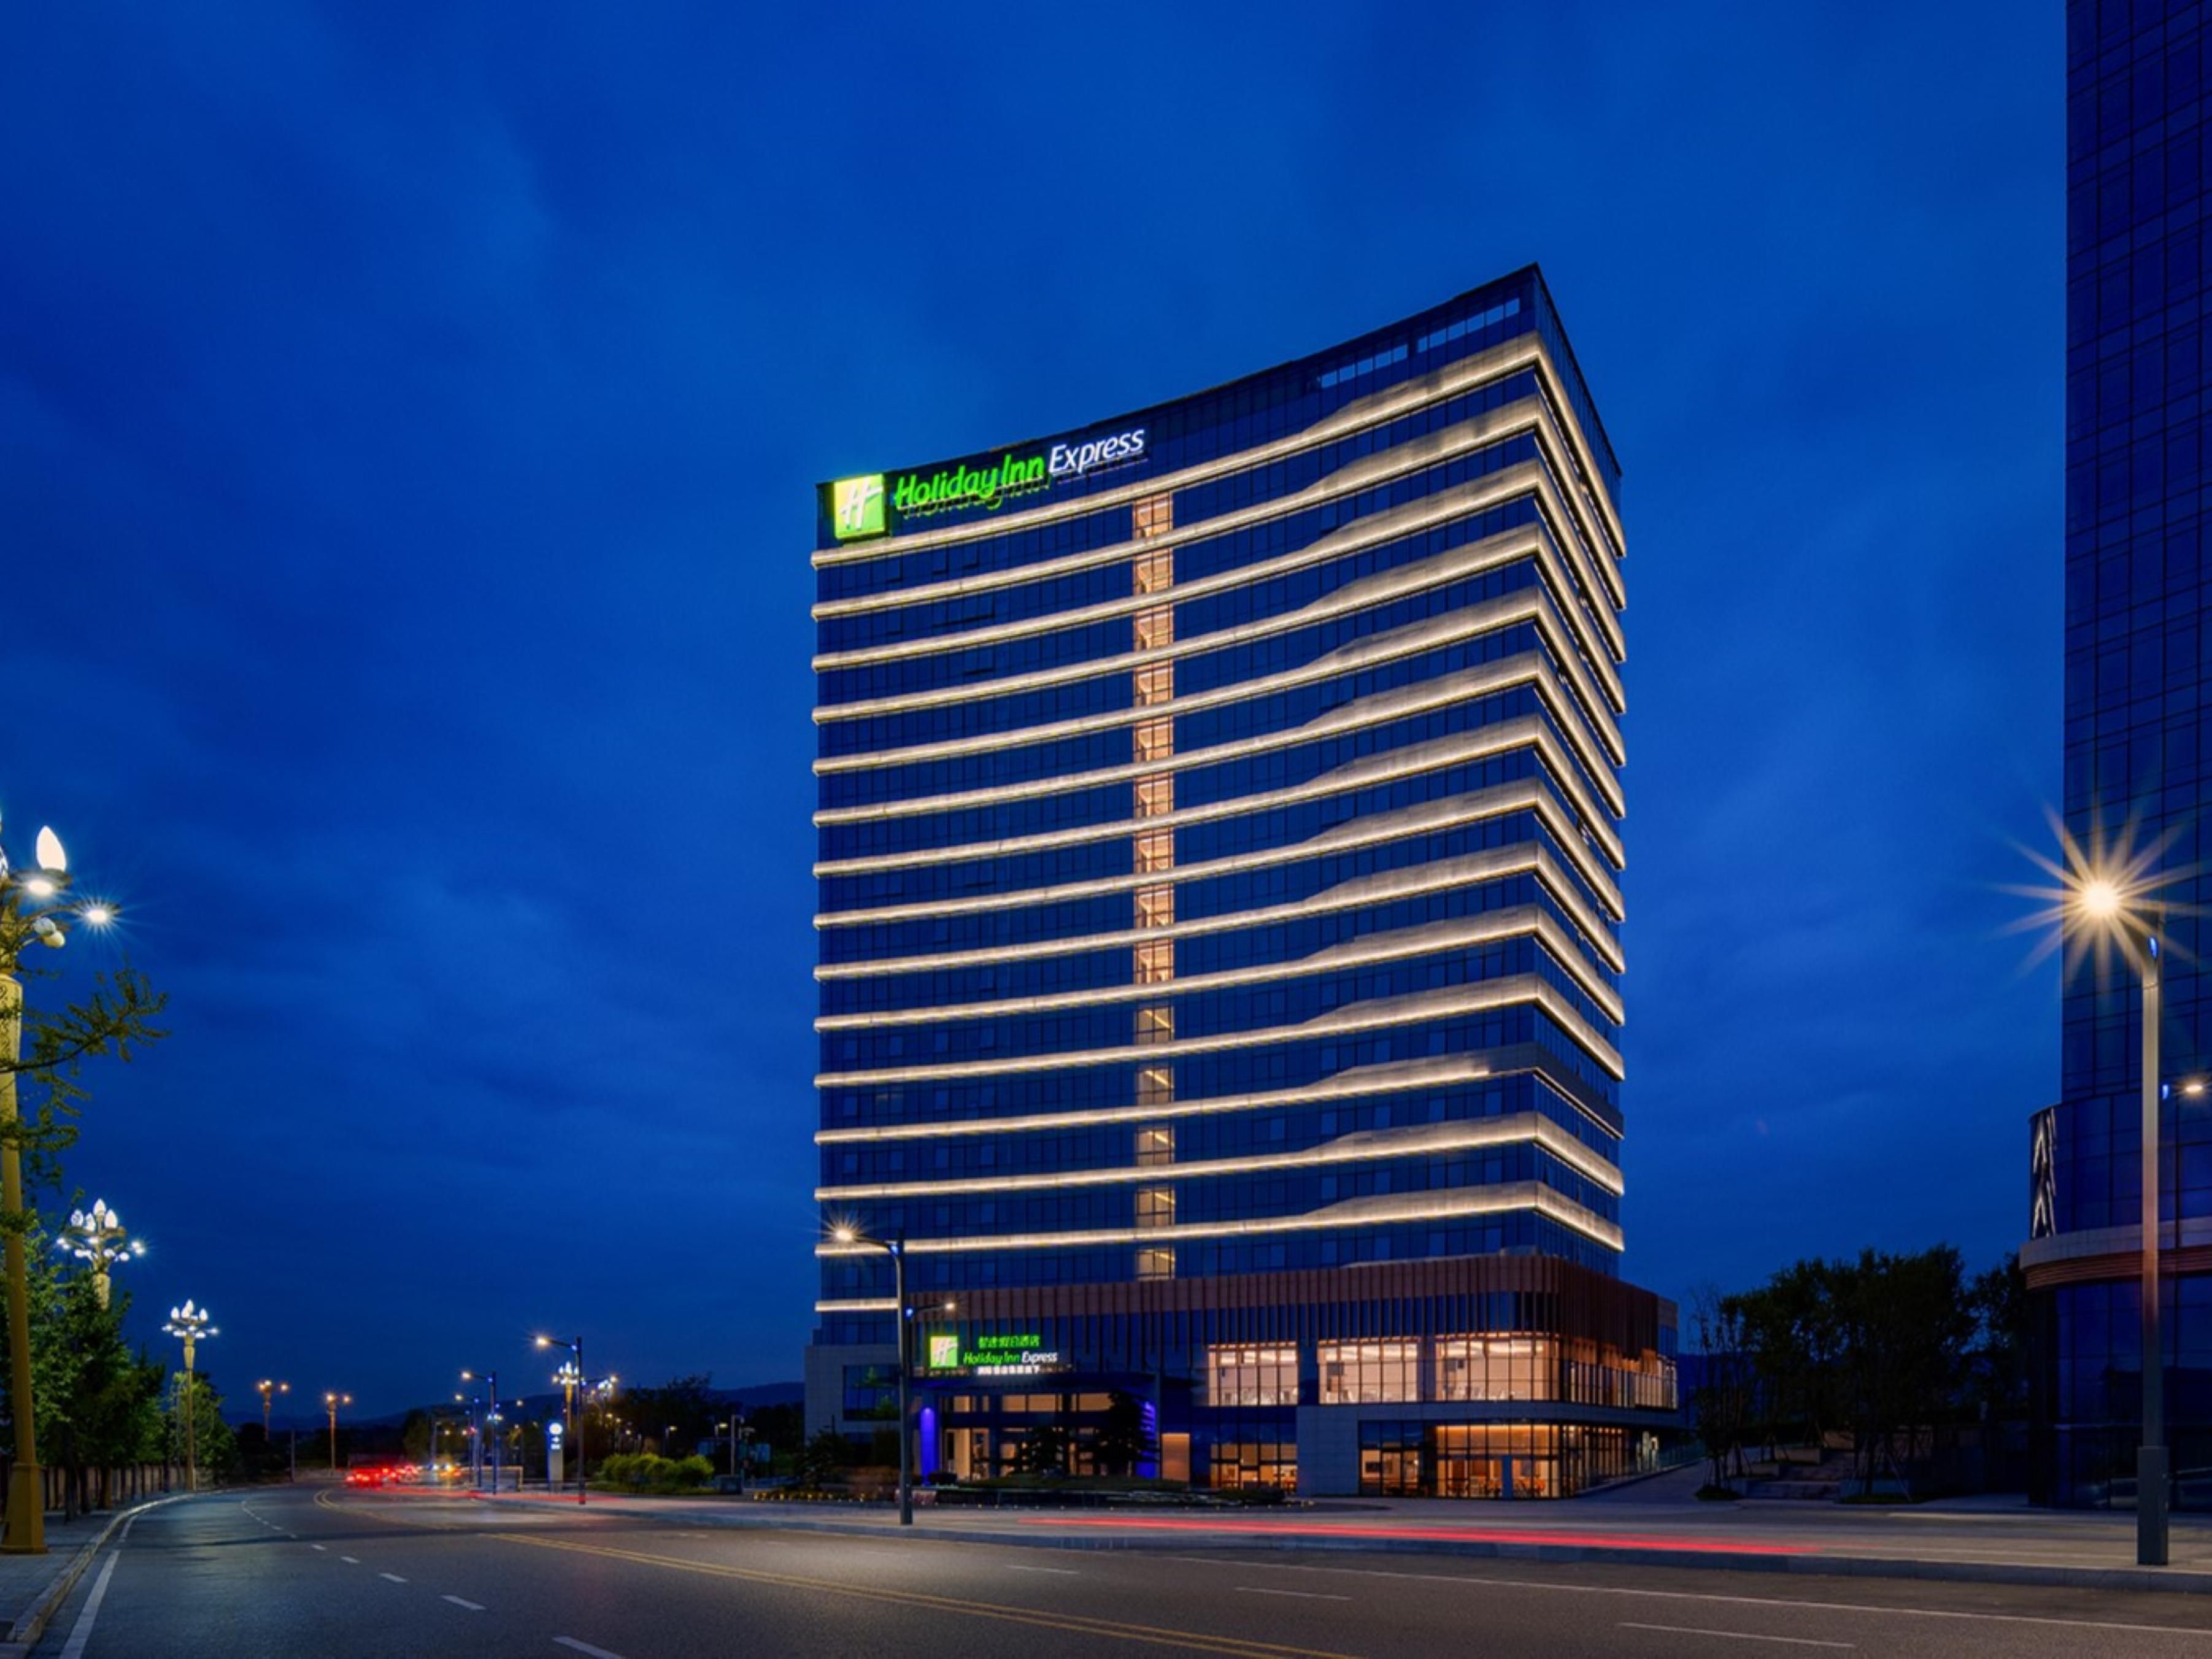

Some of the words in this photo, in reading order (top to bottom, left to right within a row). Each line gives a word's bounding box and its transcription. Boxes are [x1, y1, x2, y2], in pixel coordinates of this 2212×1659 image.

[893, 465, 998, 510] Holiday
[1001, 454, 1044, 487] Inn
[1049, 429, 1145, 473] Express
[963, 1352, 1003, 1365] Holiday
[1004, 1351, 1020, 1363] Inn
[1022, 1351, 1058, 1365] Express
